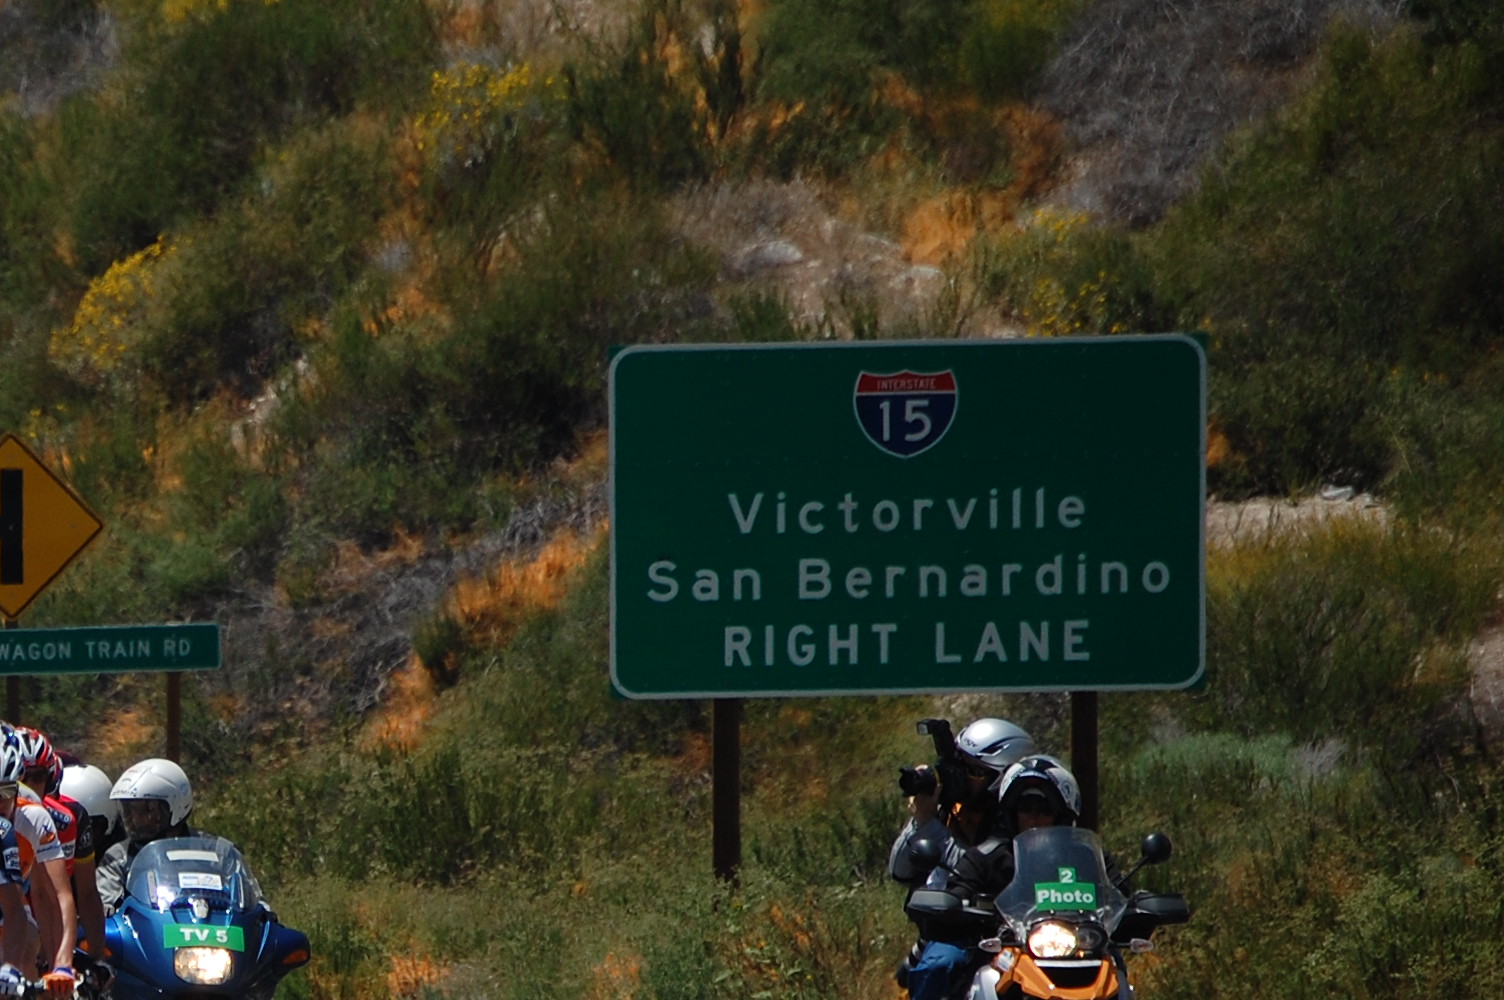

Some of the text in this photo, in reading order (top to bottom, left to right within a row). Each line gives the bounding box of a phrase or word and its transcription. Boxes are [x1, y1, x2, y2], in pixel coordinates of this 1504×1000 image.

[877, 378, 936, 390] INTERSTATE
[879, 399, 932, 442] 15
[728, 488, 1086, 534] Victorville
[647, 554, 1171, 602] San Bernardino
[85, 640, 151, 659] TRAIN
[163, 639, 192, 657] RD
[723, 619, 1091, 668] RIGHT LANE
[1061, 869, 1073, 883] 2
[1037, 889, 1094, 903] Photo
[180, 927, 228, 943] TV 5
